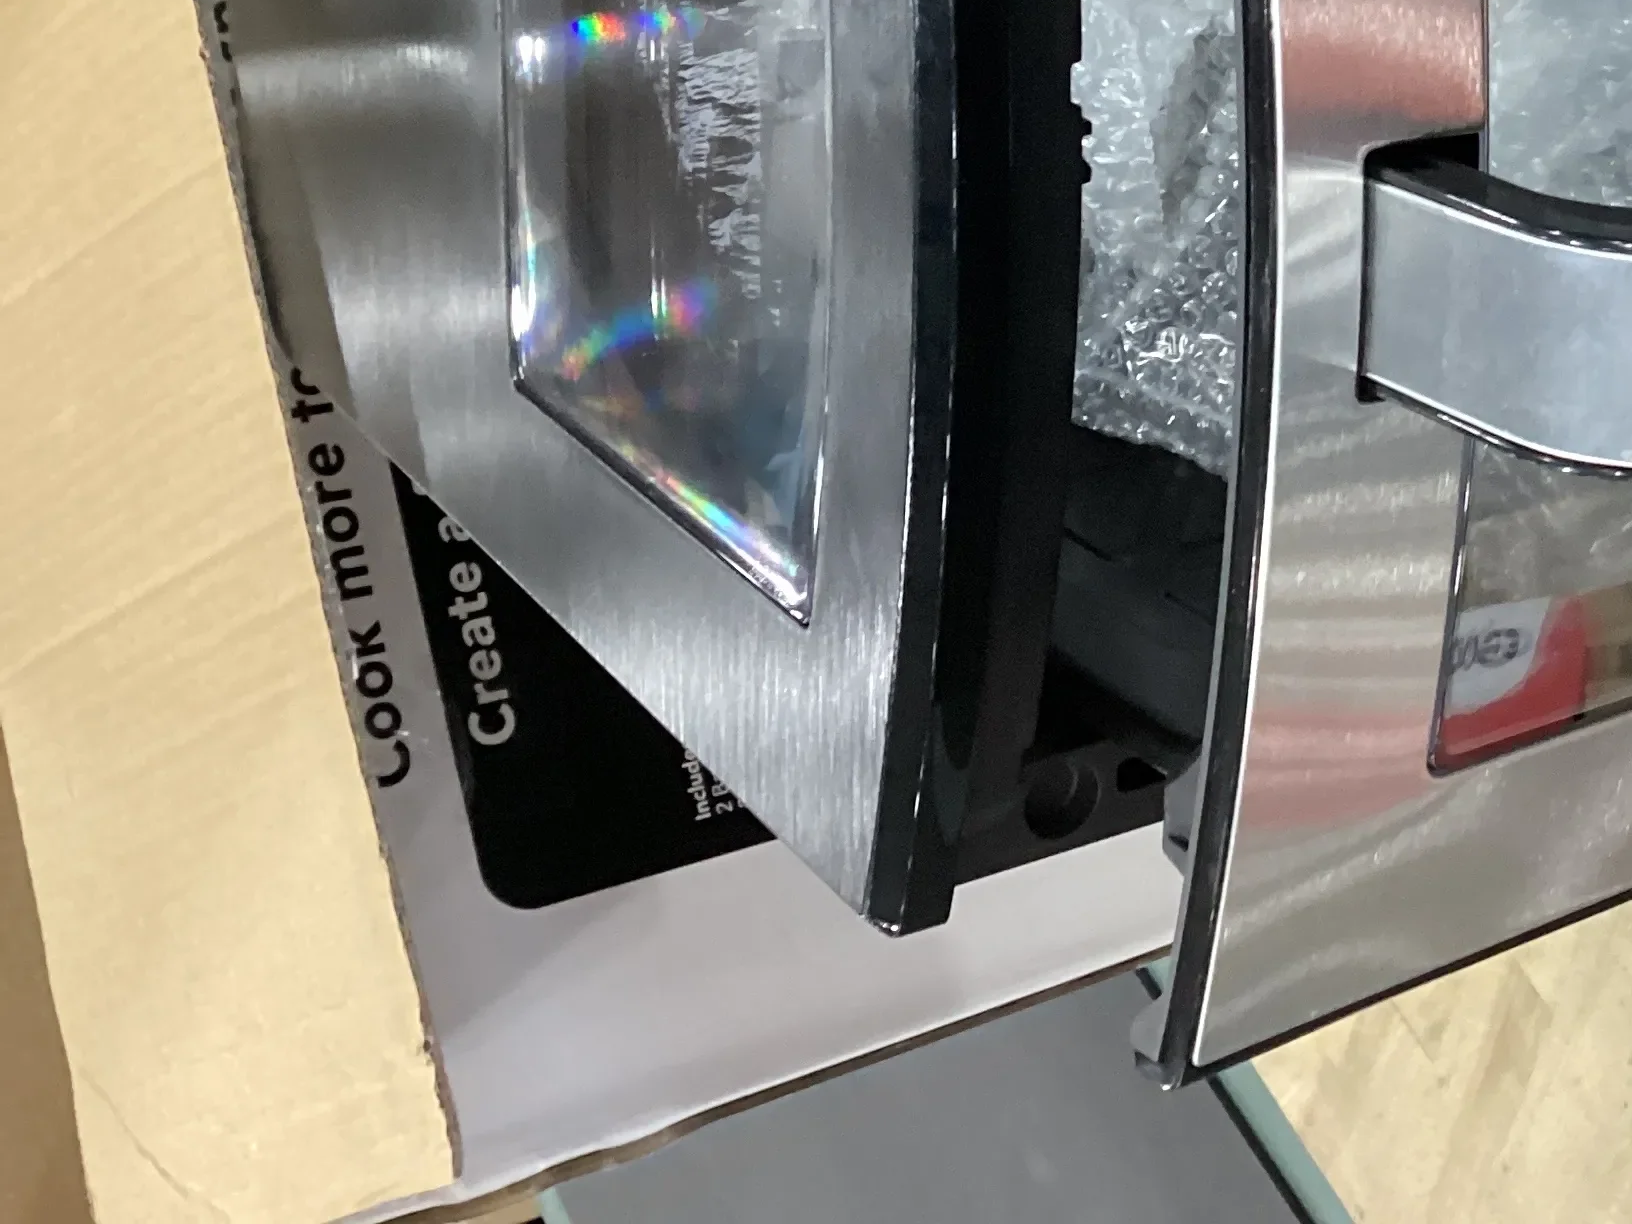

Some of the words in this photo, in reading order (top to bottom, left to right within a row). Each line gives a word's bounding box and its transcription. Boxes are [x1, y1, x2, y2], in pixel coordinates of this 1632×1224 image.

[307, 443, 374, 601] more
[446, 561, 516, 746] Create
[715, 799, 734, 815] 2
